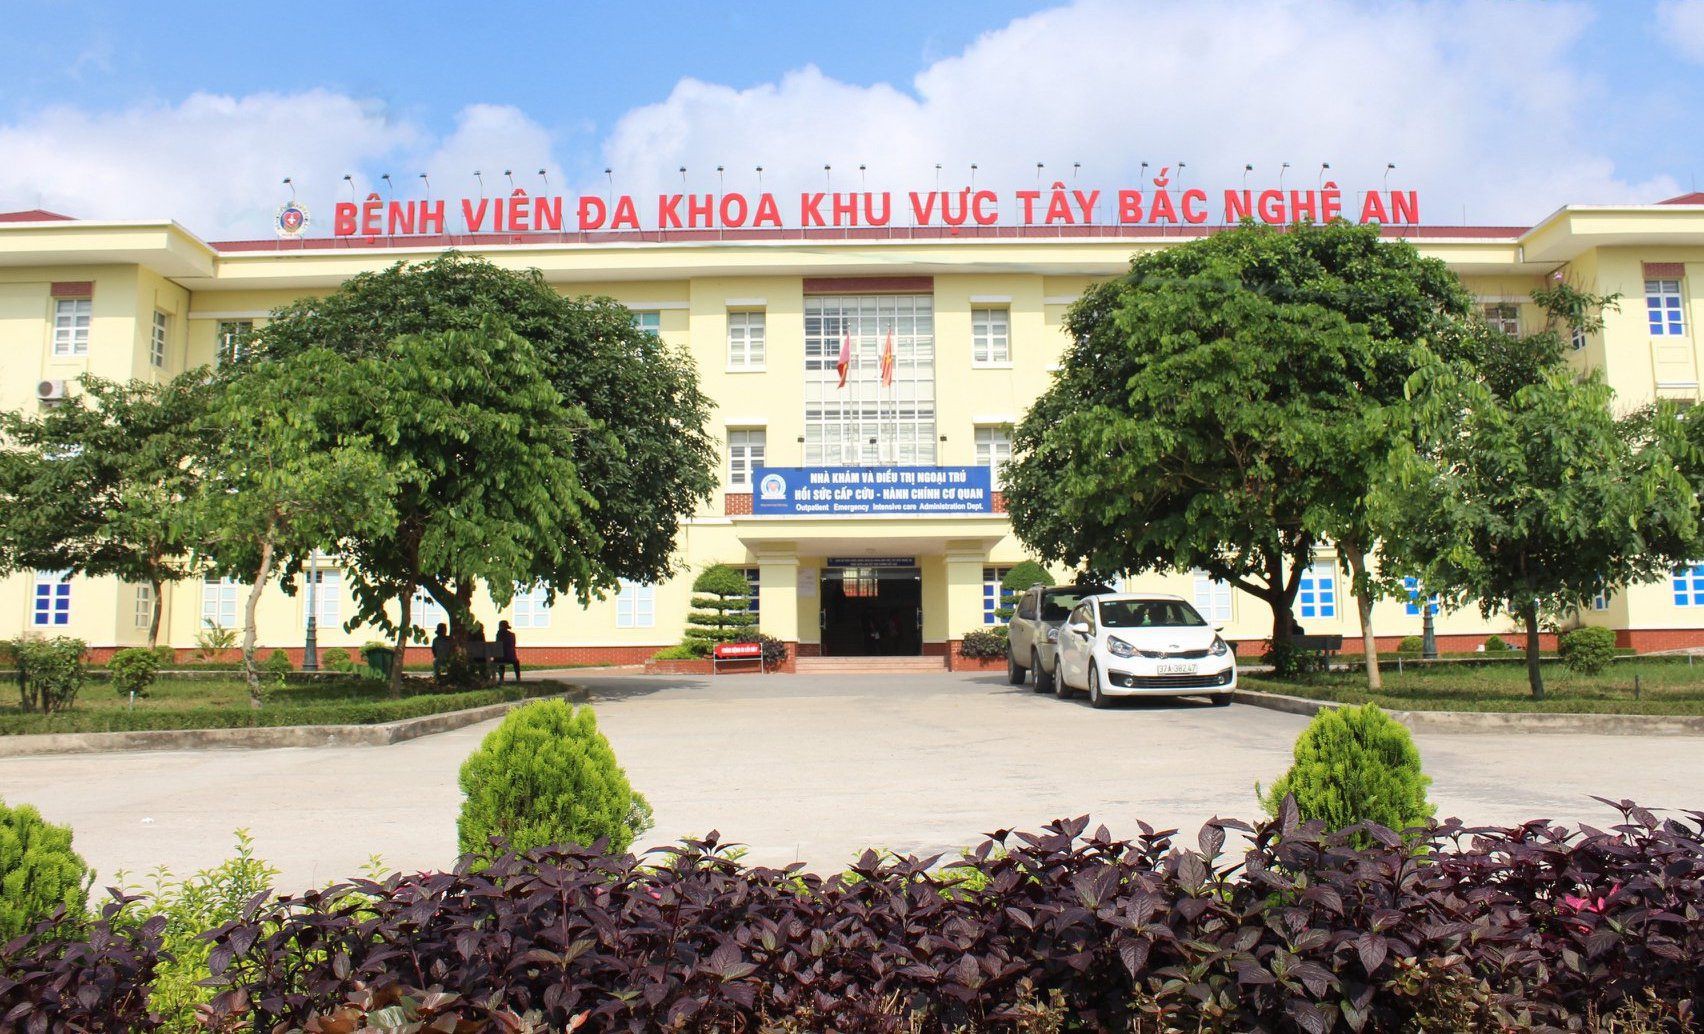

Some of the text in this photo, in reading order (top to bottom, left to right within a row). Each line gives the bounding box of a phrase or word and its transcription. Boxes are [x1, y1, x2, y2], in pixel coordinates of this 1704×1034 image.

[335, 193, 444, 244] BỆNH
[461, 188, 561, 241] VIỆN
[576, 195, 640, 229] ĐA
[658, 192, 783, 228] KHOA
[800, 191, 891, 227] KHU
[909, 186, 998, 235] VỰC
[1016, 181, 1100, 225] TÂY
[1118, 167, 1208, 224] BẮC
[1360, 190, 1419, 224] AN
[810, 470, 830, 483] NHÀ
[832, 470, 860, 483] KHÁM
[861, 470, 874, 483] VÀ
[900, 472, 915, 485] TRỊ
[917, 472, 946, 485] NGOẠI
[834, 486, 853, 500] CẤP
[883, 486, 909, 500] HÀNH
[911, 486, 940, 500] CHÍNH
[942, 488, 956, 499] CƠ
[957, 488, 984, 500] QUAN
[796, 503, 829, 512] Outpatient
[833, 503, 869, 512] Emergency
[872, 502, 901, 510] Intensive
[919, 502, 966, 510] Administration
[967, 502, 984, 511] Dept.
